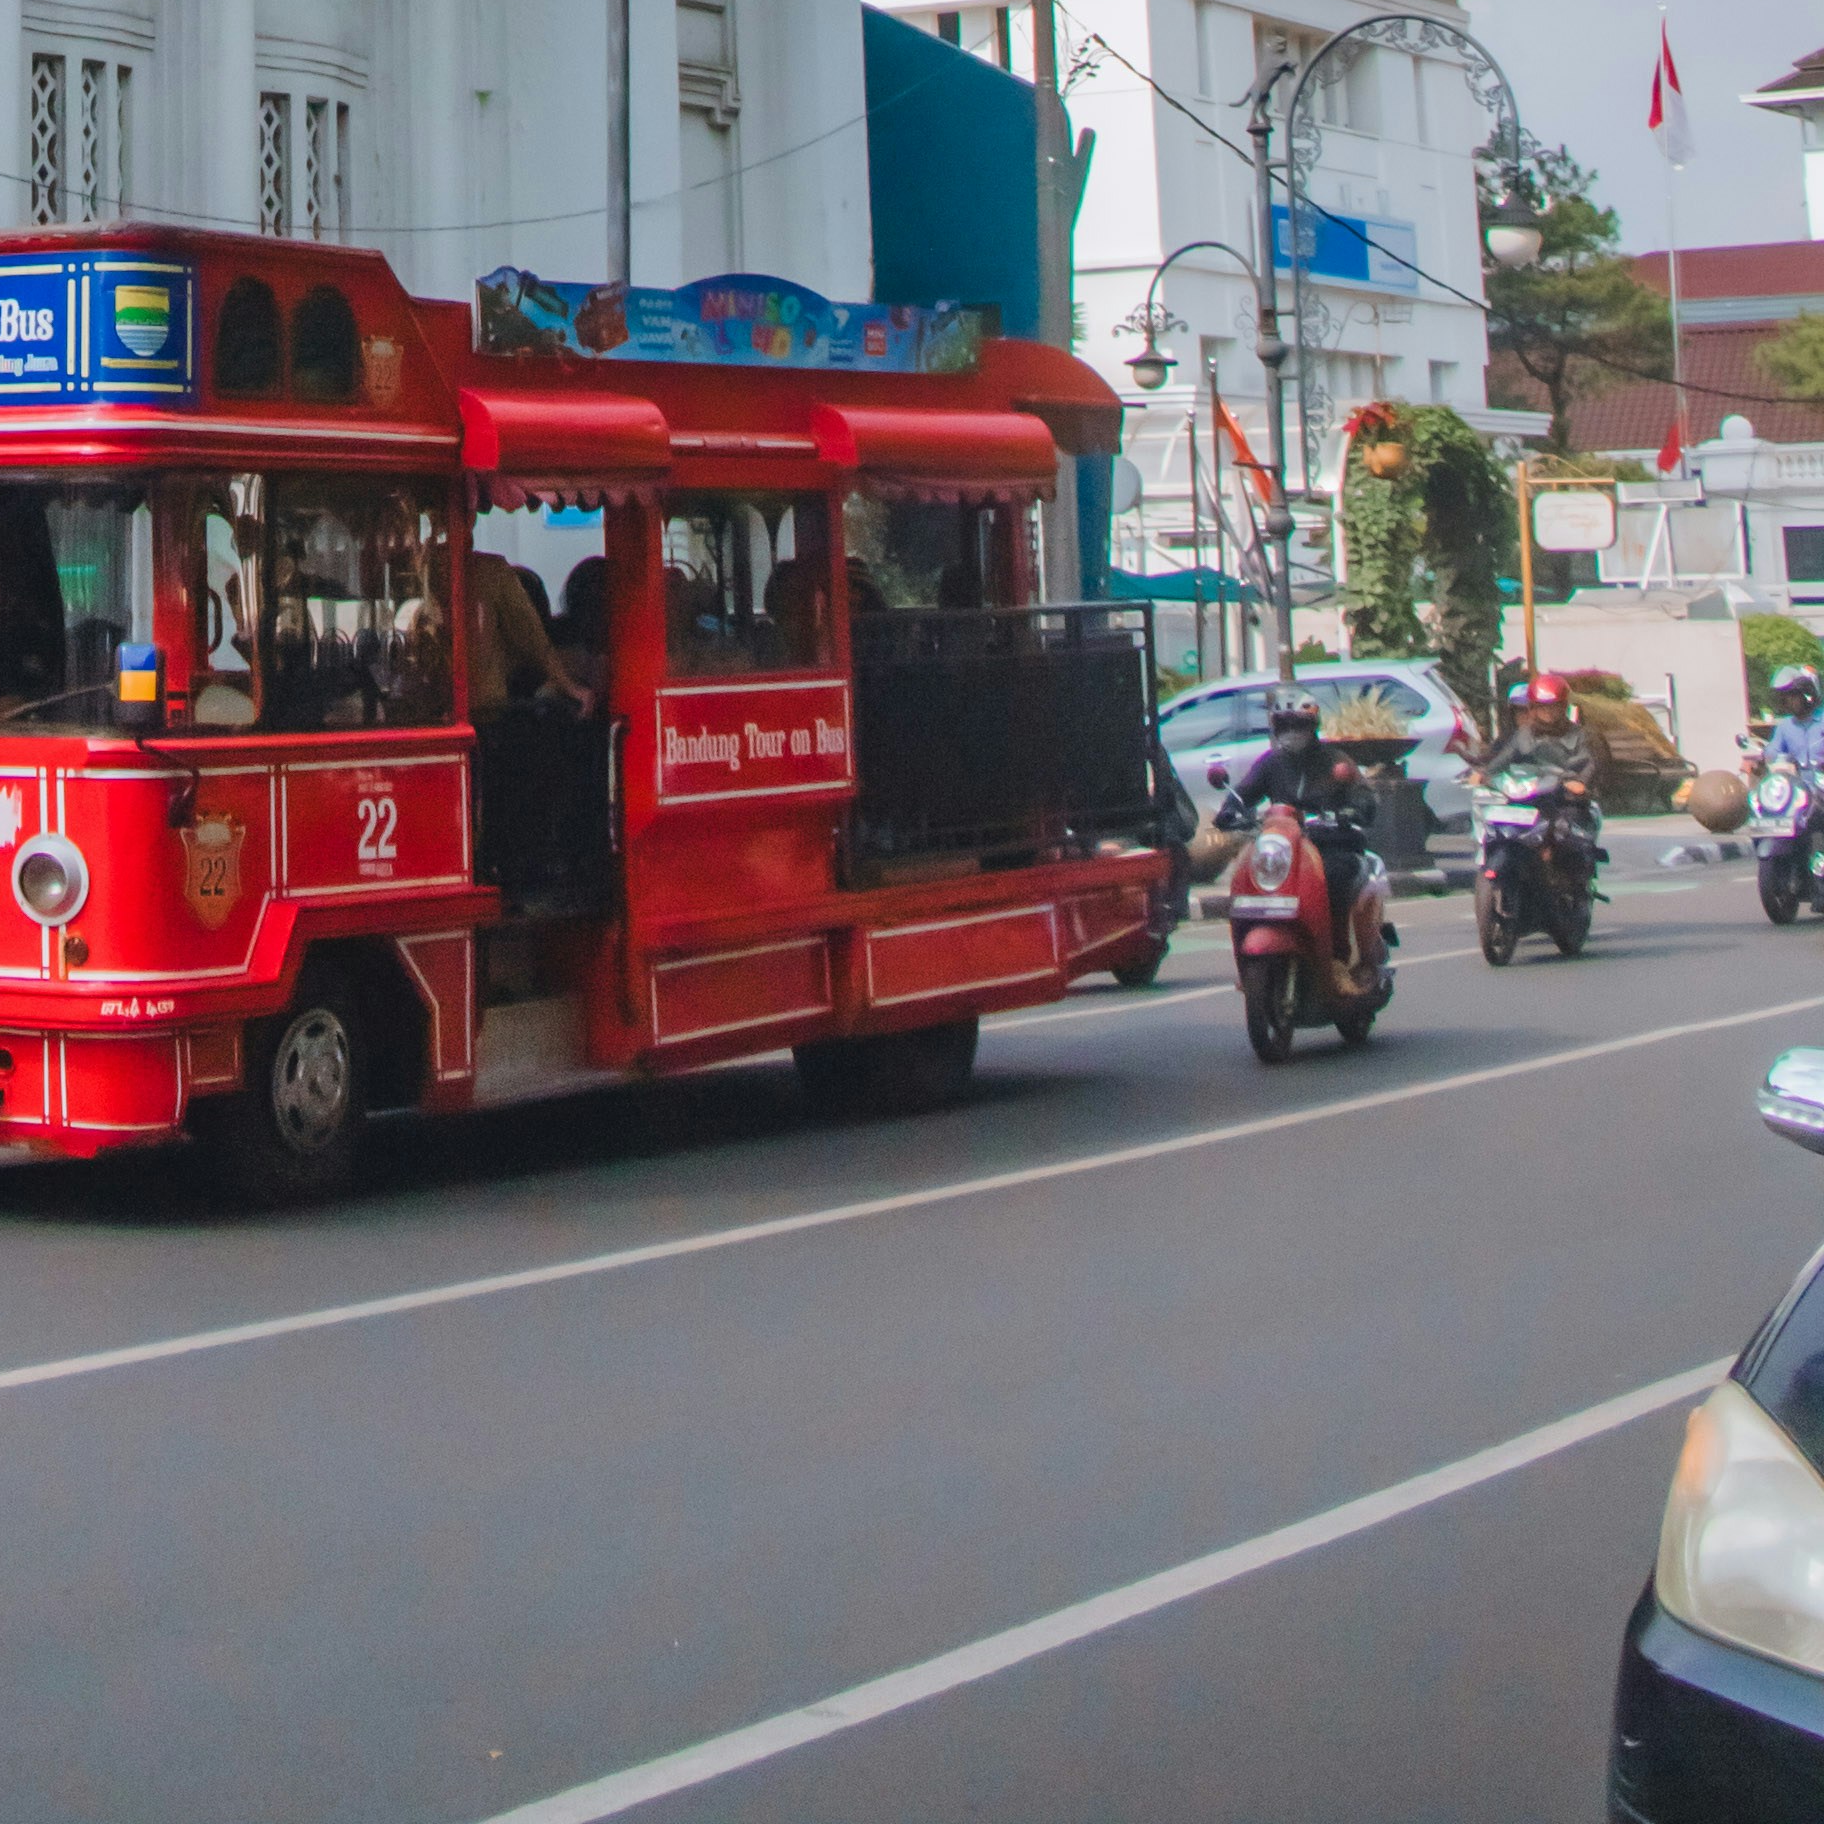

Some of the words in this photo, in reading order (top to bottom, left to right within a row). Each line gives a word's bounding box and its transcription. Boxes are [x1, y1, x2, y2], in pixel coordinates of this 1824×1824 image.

[664, 725, 741, 771] Bandung
[744, 722, 786, 759] Tour
[790, 728, 811, 756] on
[815, 718, 845, 756] Bus
[357, 798, 398, 860] 22
[199, 856, 227, 897] 22
